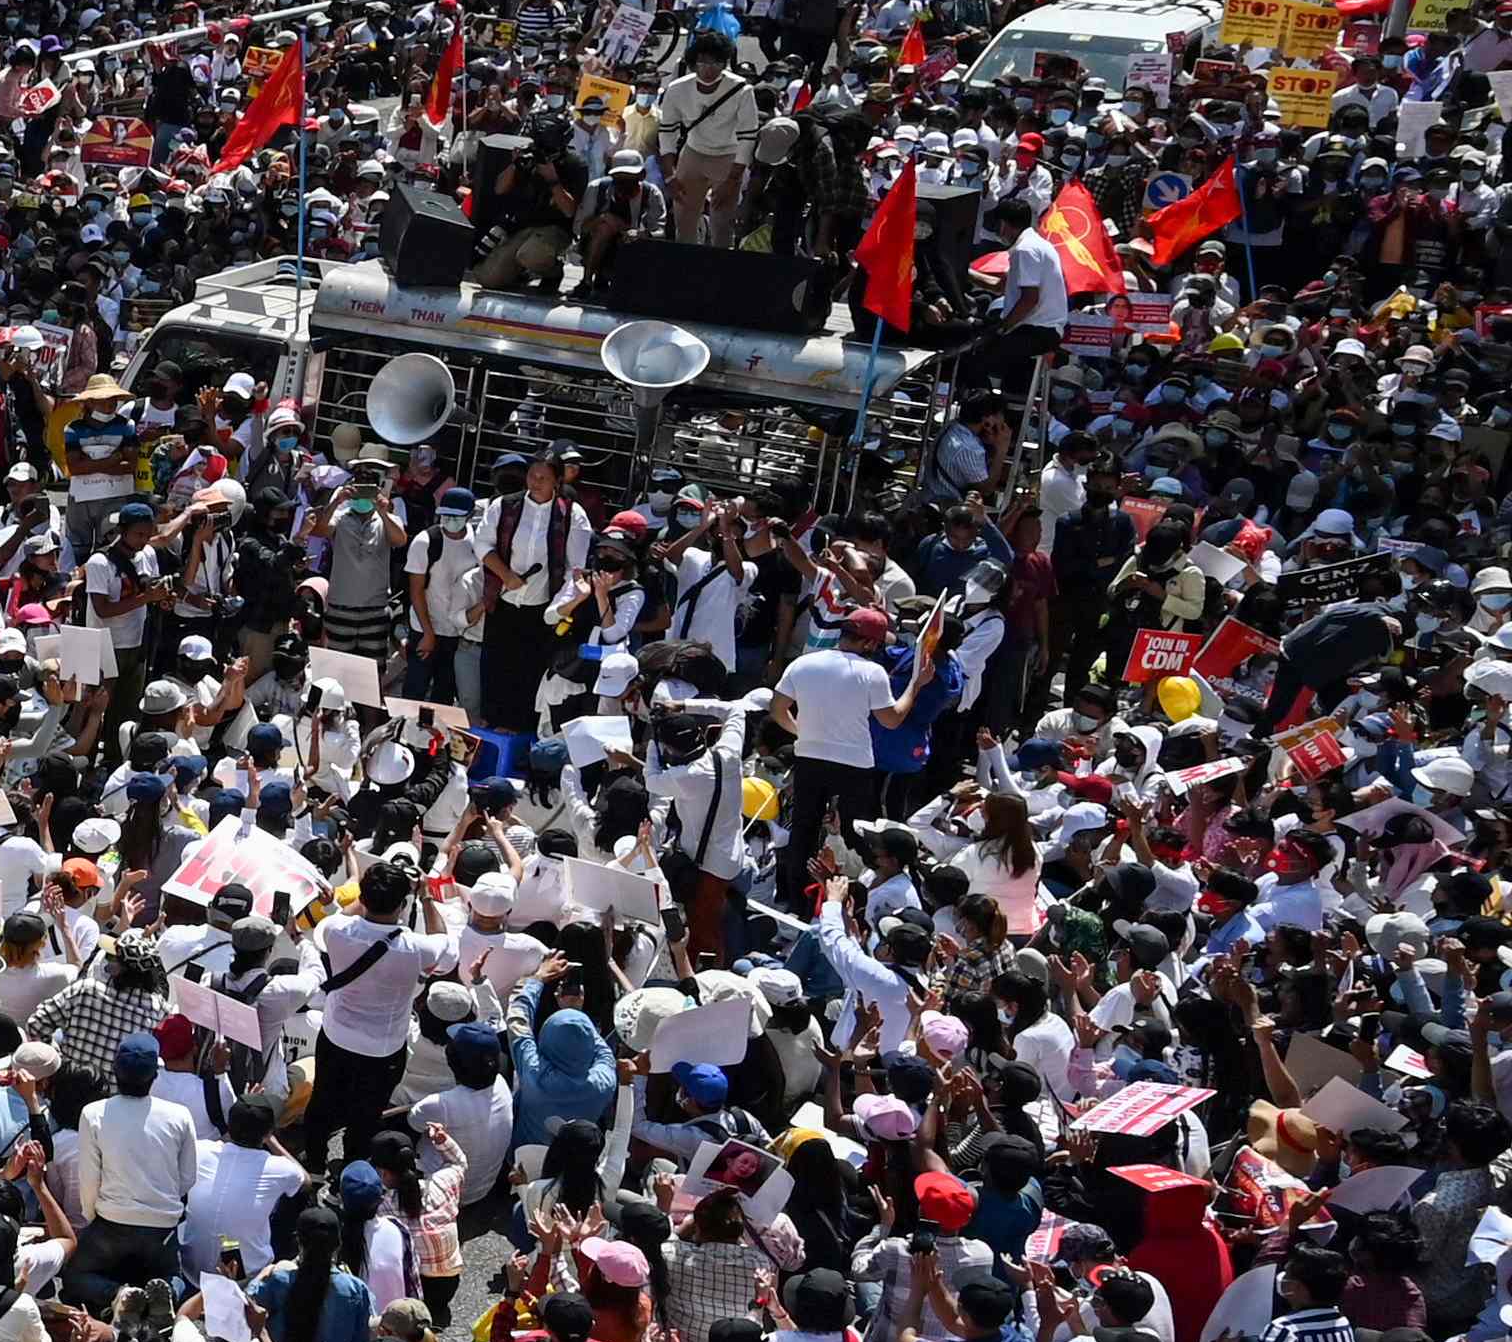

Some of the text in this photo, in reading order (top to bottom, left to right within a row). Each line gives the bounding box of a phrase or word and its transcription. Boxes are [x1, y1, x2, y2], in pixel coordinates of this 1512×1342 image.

[1294, 9, 1340, 29] STOP
[1424, 3, 1448, 15] Our
[1271, 75, 1333, 95] STOP
[349, 299, 446, 325] THEIN THAN
[1175, 638, 1190, 652] IN
